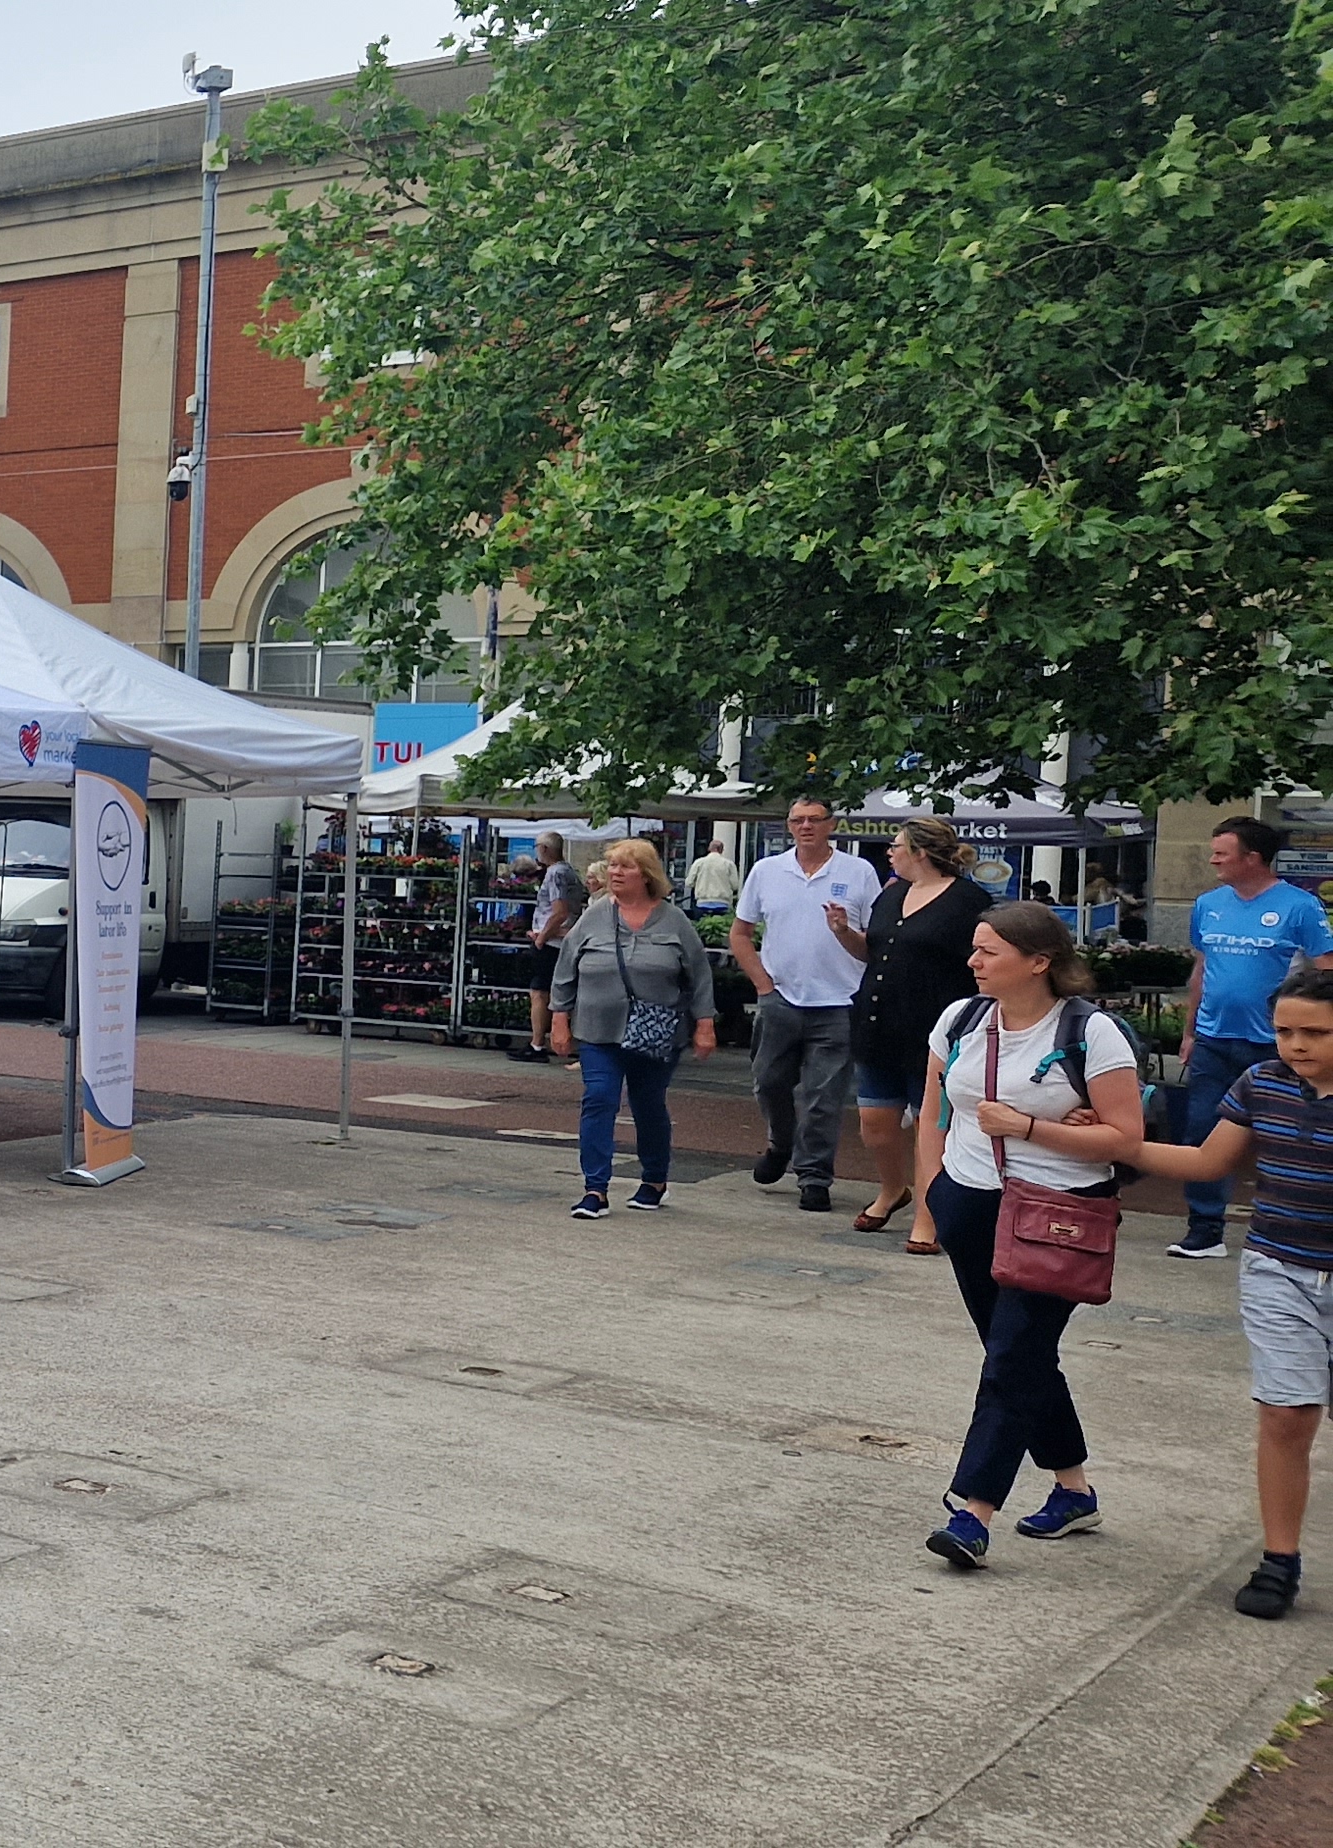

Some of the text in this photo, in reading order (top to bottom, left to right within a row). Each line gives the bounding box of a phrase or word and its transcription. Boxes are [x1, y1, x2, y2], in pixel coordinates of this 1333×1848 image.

[44, 730, 63, 743] your
[43, 747, 77, 764] marke
[374, 742, 423, 764] TUI
[836, 817, 1009, 839] Ashto rket
[95, 900, 122, 921] Support
[1201, 933, 1275, 948] ETIHAD
[1212, 946, 1259, 956] AIRWAYS
